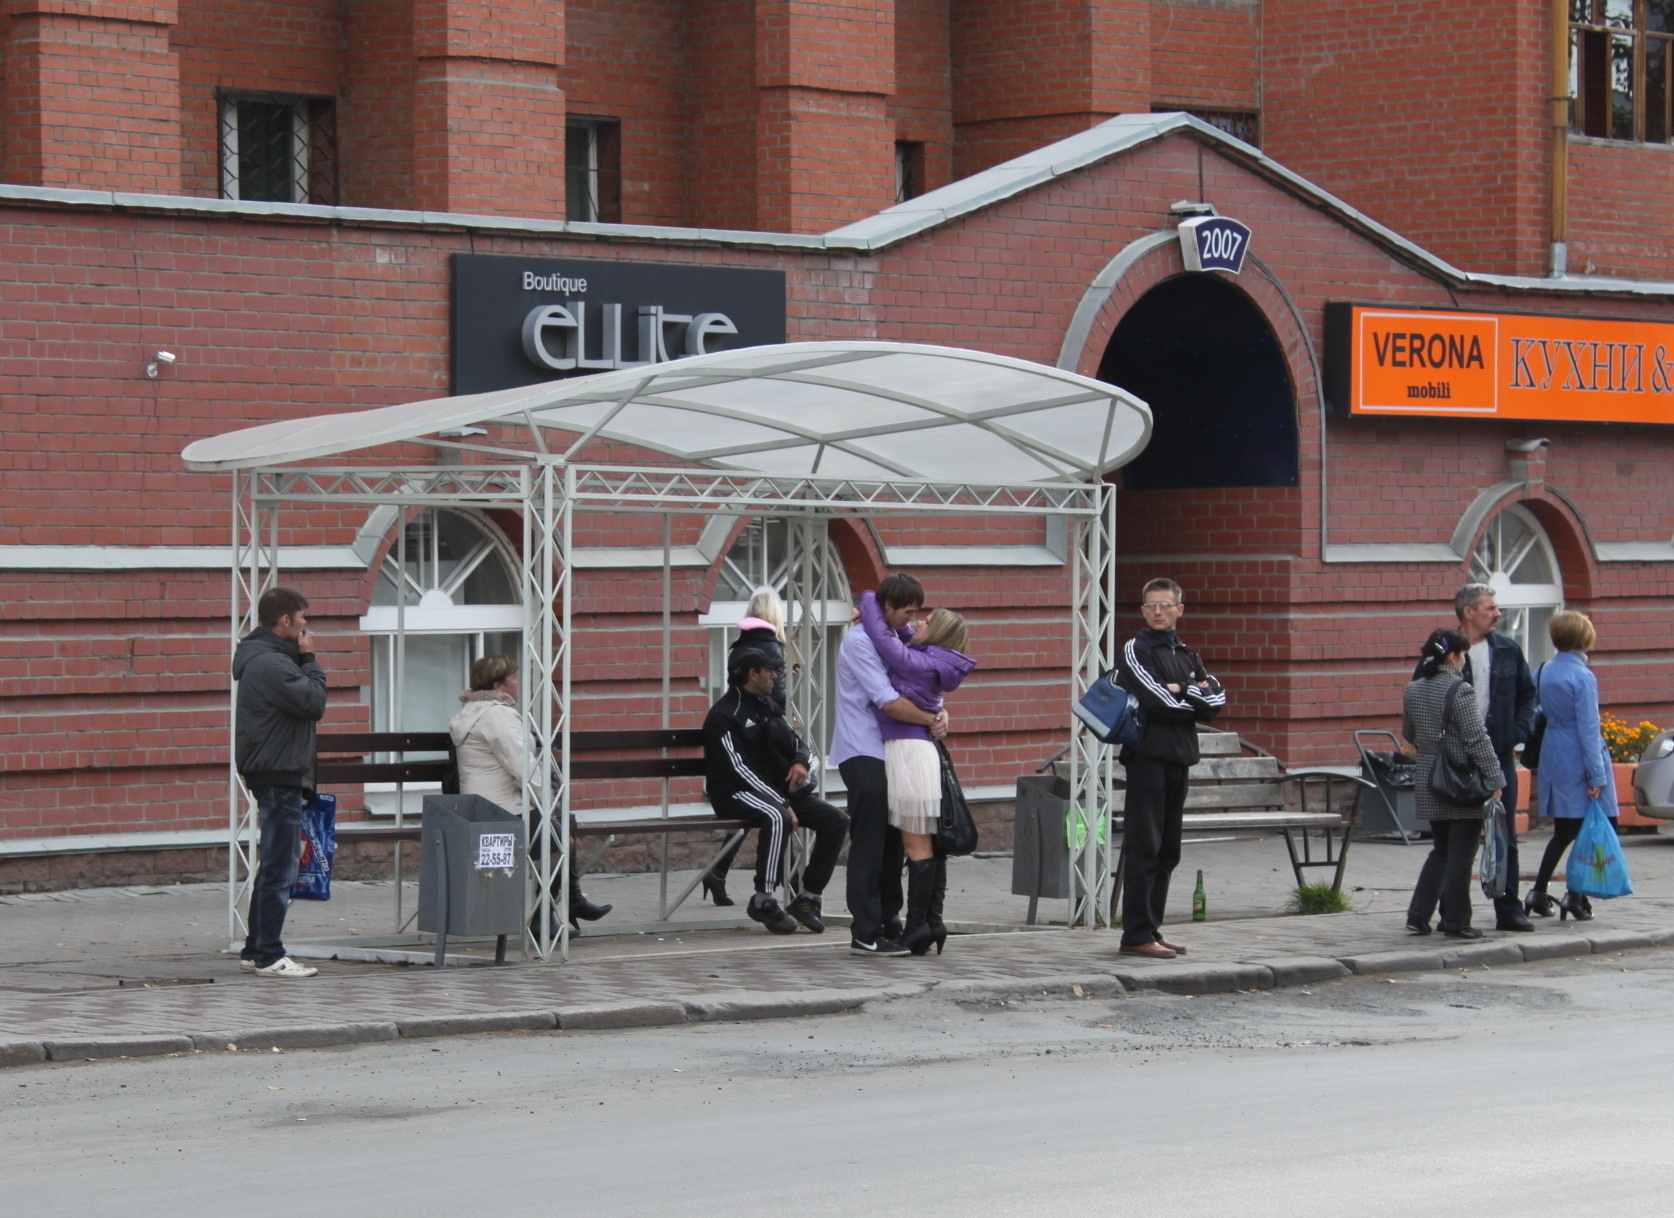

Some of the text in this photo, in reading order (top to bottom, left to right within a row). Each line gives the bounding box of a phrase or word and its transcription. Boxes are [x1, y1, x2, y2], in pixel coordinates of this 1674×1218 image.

[1202, 227, 1242, 262] 2007
[522, 271, 588, 296] Boutique
[1373, 332, 1485, 370] VERONA
[1509, 338, 1674, 394] КУХНИ &
[1407, 382, 1451, 399] mobili
[481, 835, 513, 848] КВАРТИРЫ
